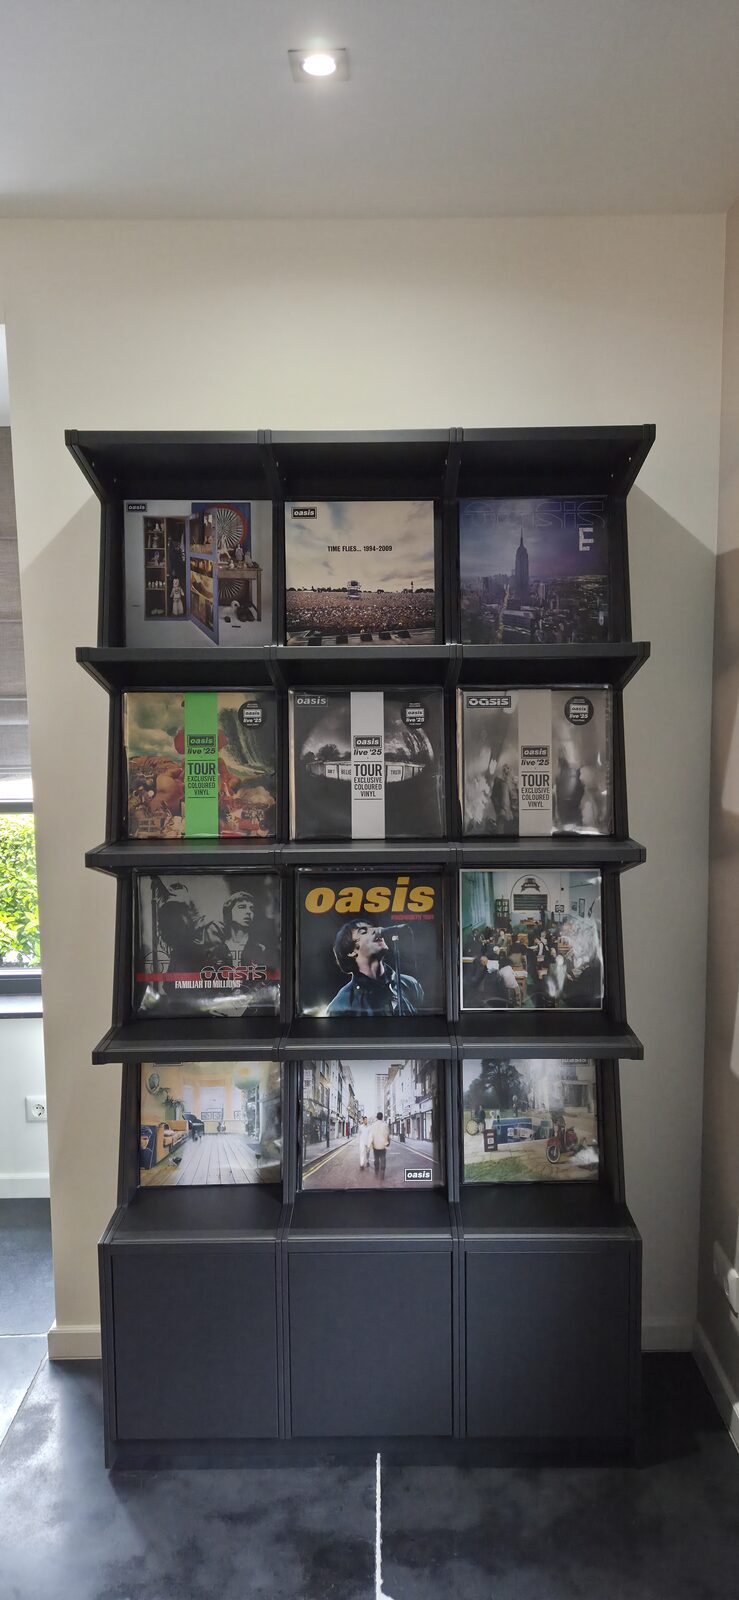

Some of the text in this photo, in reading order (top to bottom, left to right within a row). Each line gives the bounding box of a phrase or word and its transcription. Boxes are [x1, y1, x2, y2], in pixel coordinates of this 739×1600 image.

[293, 507, 315, 516] oasis
[578, 527, 594, 551] E
[297, 697, 326, 705] oasis
[190, 737, 213, 745] oasis
[187, 747, 216, 755] live '25
[523, 748, 547, 756] oasis
[188, 763, 216, 775] TOUR
[354, 764, 383, 776] TOUR
[521, 774, 550, 787] TOUR
[305, 876, 435, 913] oasis
[175, 981, 203, 989] FAMILIAR
[406, 1171, 430, 1179] oasis
